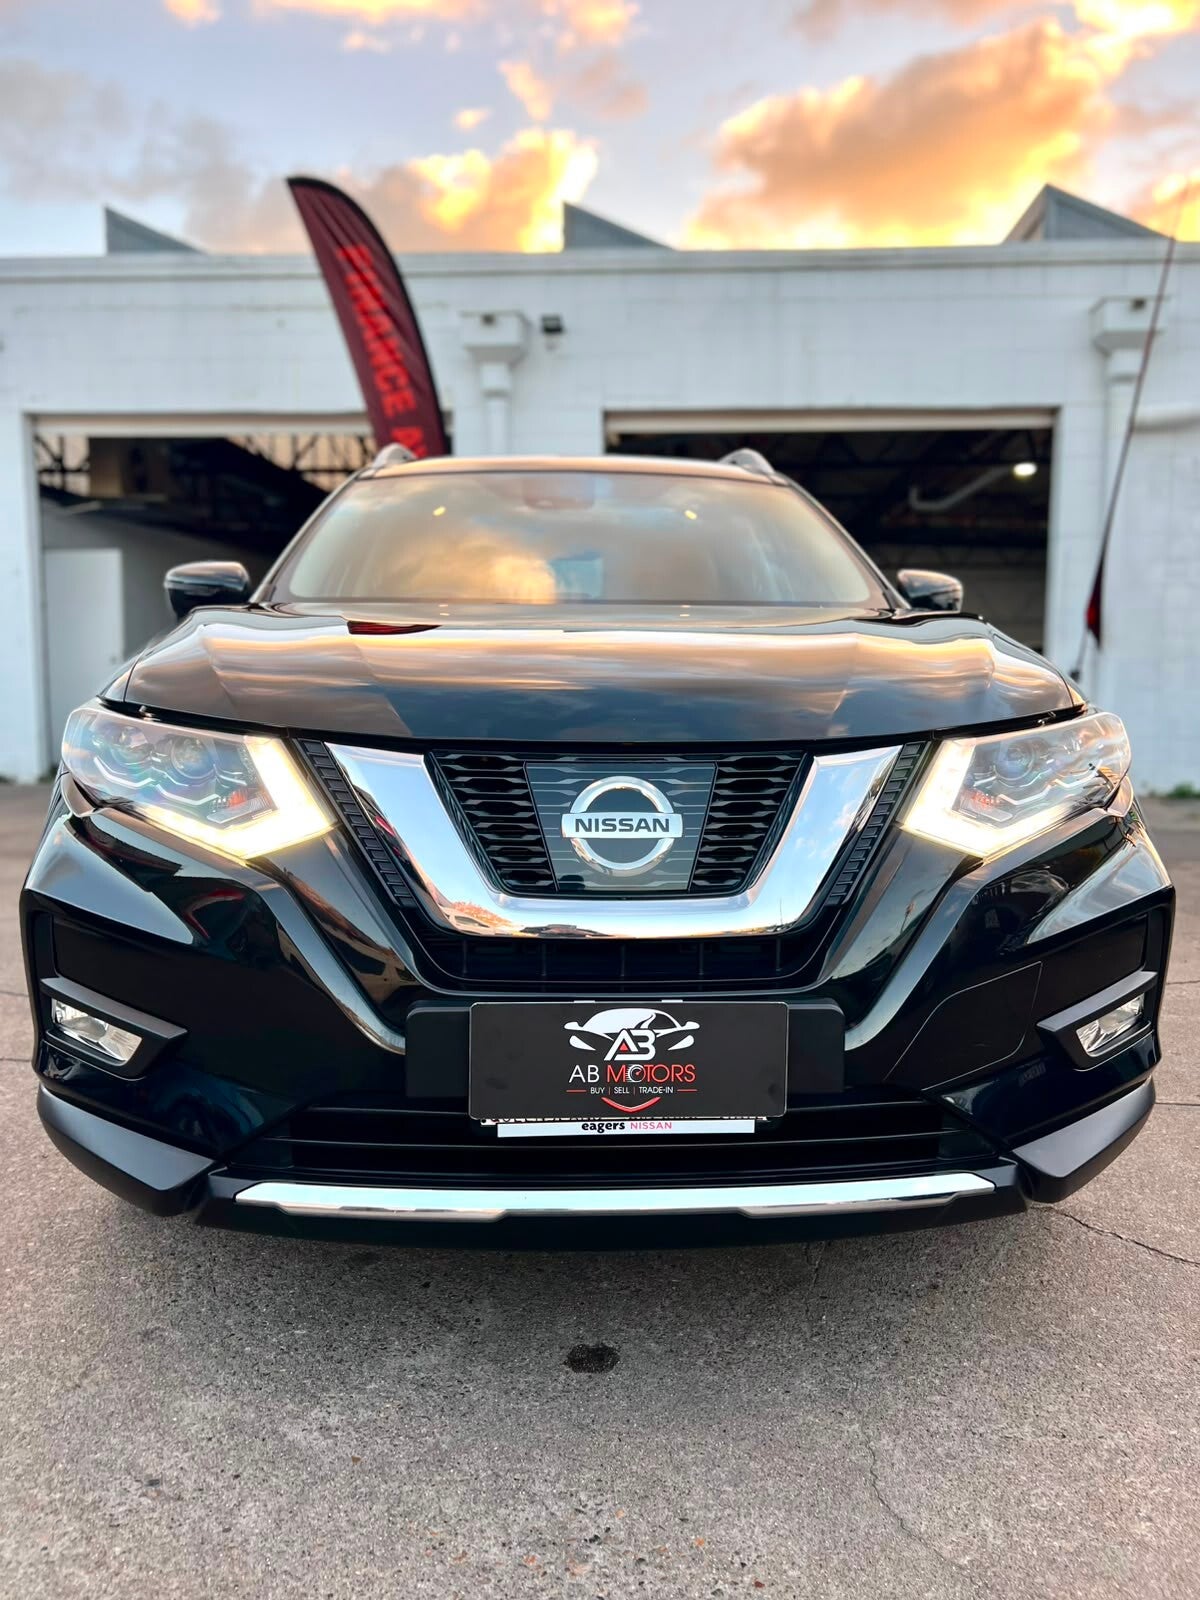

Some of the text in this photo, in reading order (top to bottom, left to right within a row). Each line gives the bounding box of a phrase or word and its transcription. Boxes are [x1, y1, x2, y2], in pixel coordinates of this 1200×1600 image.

[335, 243, 416, 418] FINANCE
[575, 818, 670, 833] NISSAN
[603, 1028, 657, 1061] AB
[568, 1063, 696, 1083] AB MOTORS
[590, 1086, 674, 1095] BUY SELL TRADE-IN
[581, 1121, 673, 1134] eagers NISSAN
